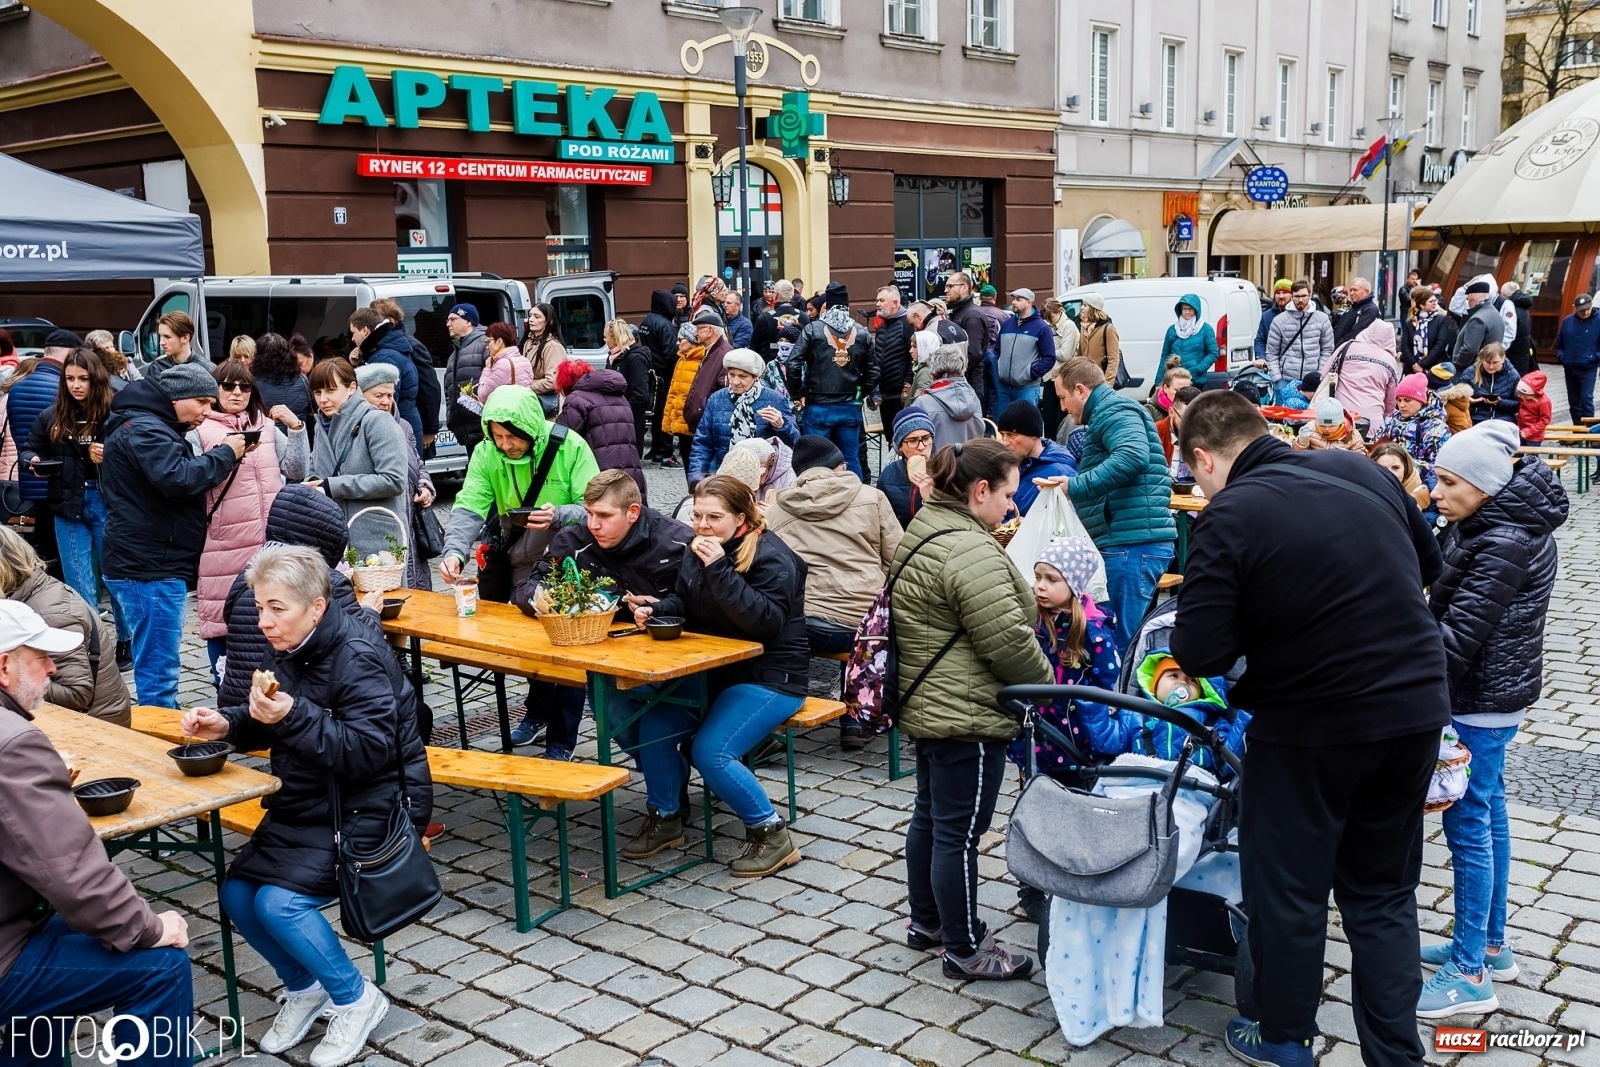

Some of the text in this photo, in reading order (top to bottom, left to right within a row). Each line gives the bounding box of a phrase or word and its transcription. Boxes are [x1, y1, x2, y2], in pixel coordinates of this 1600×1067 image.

[746, 51, 762, 62] 1953
[318, 65, 674, 143] APTEKA
[568, 144, 669, 161] POD RÓŻAMI
[369, 159, 424, 174] RYNEK
[427, 161, 446, 175] 12
[457, 162, 527, 178] CENTRUM
[530, 165, 647, 182] FARMACEUTYCZNE
[1423, 154, 1453, 183] Browar
[1254, 180, 1280, 188] KANTOR
[0, 240, 69, 262] orz.pl
